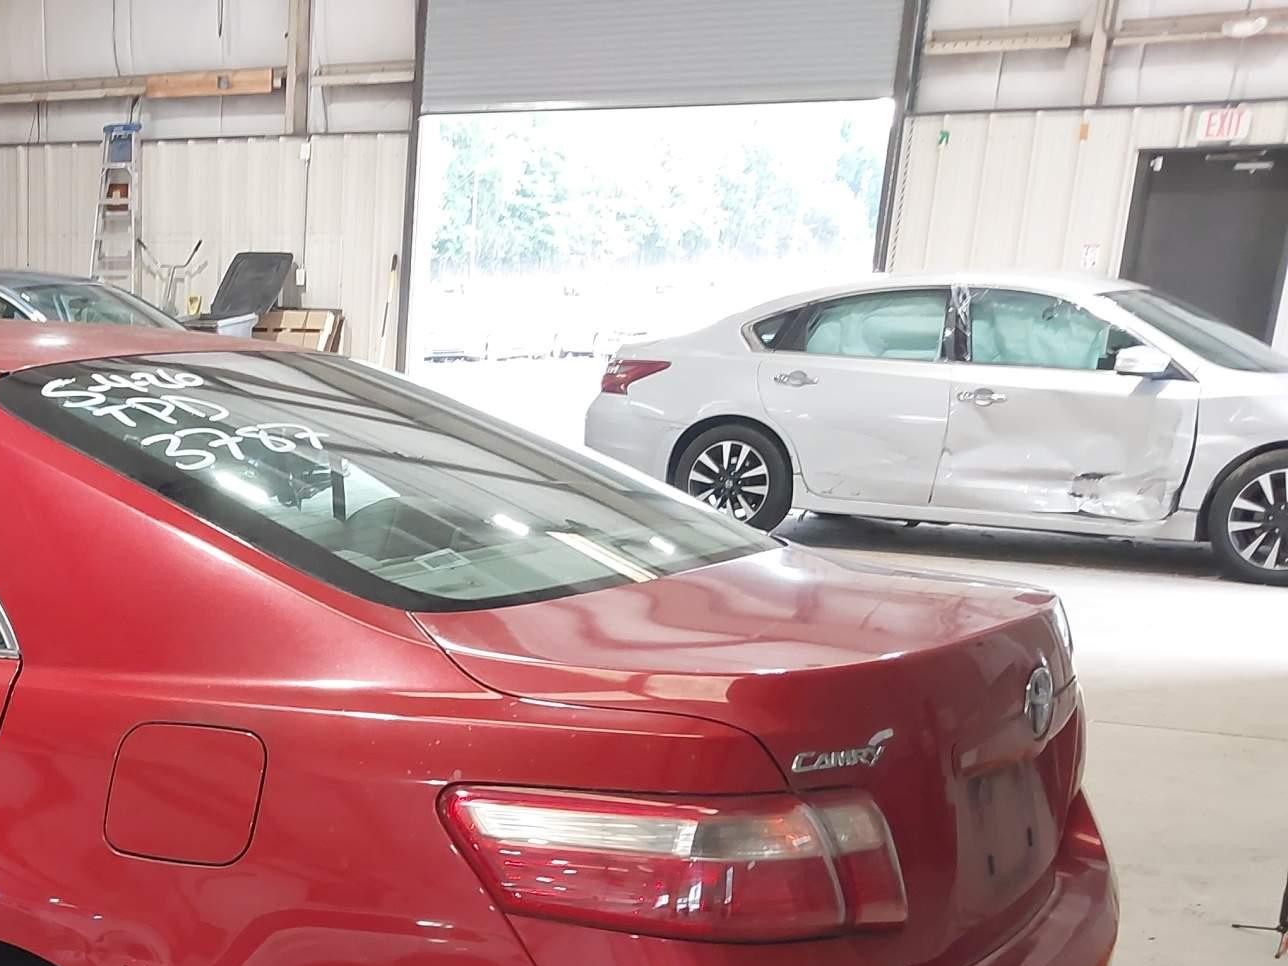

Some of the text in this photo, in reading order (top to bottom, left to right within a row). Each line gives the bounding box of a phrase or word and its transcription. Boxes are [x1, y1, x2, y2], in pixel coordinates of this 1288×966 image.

[1204, 107, 1246, 138] EXIT
[140, 422, 330, 471] 3787
[791, 727, 895, 773] CAMRY
